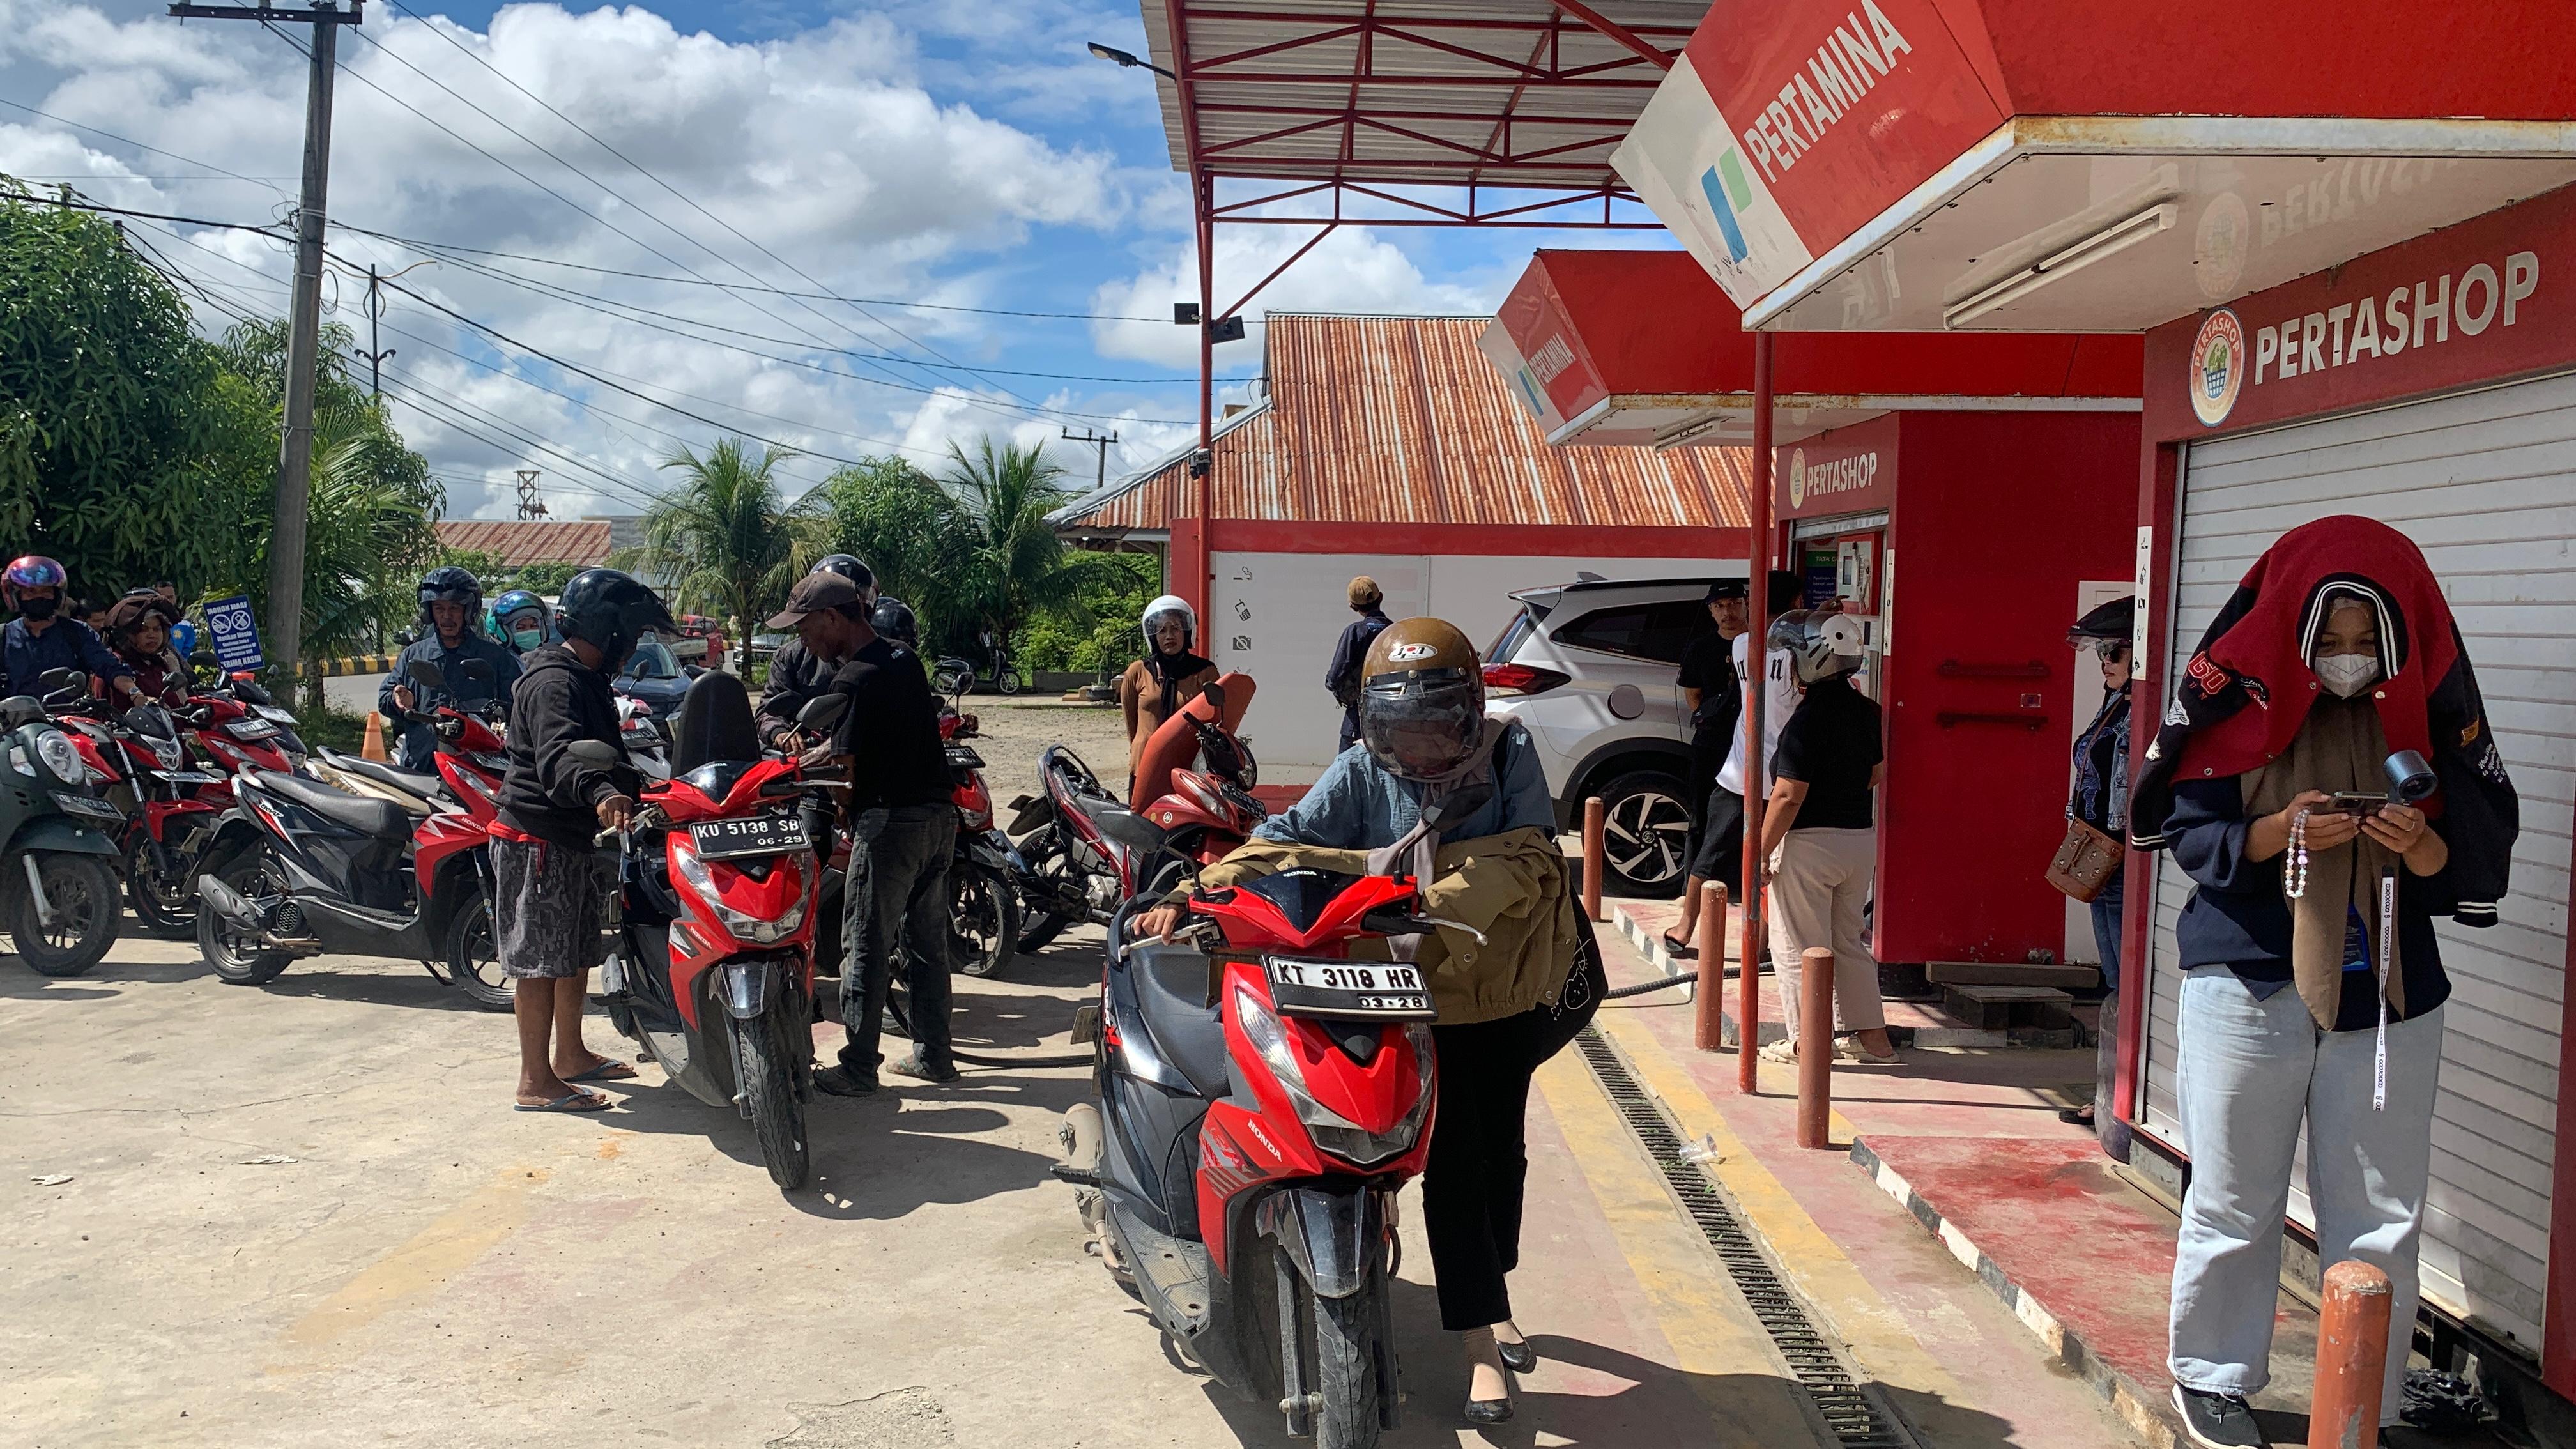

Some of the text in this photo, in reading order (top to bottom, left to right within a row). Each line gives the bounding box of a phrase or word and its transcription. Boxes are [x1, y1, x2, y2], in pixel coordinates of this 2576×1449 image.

[1743, 0, 1912, 183] PERTAMINA
[2254, 250, 2540, 386] PERTASHOP
[1528, 332, 1576, 387] PERTAMINA
[2194, 317, 2240, 367] PERTASHOP
[1807, 452, 1878, 497] PERTASHOP
[206, 601, 247, 615] MOHON MAAF
[242, 654, 261, 665] KASIH
[461, 816, 487, 833] HONDA
[697, 819, 799, 839] KU 5138 SB
[690, 925, 712, 949] HONDA
[1278, 963, 1417, 988] KT 3118 HR
[1247, 1118, 1283, 1163] HONDA
